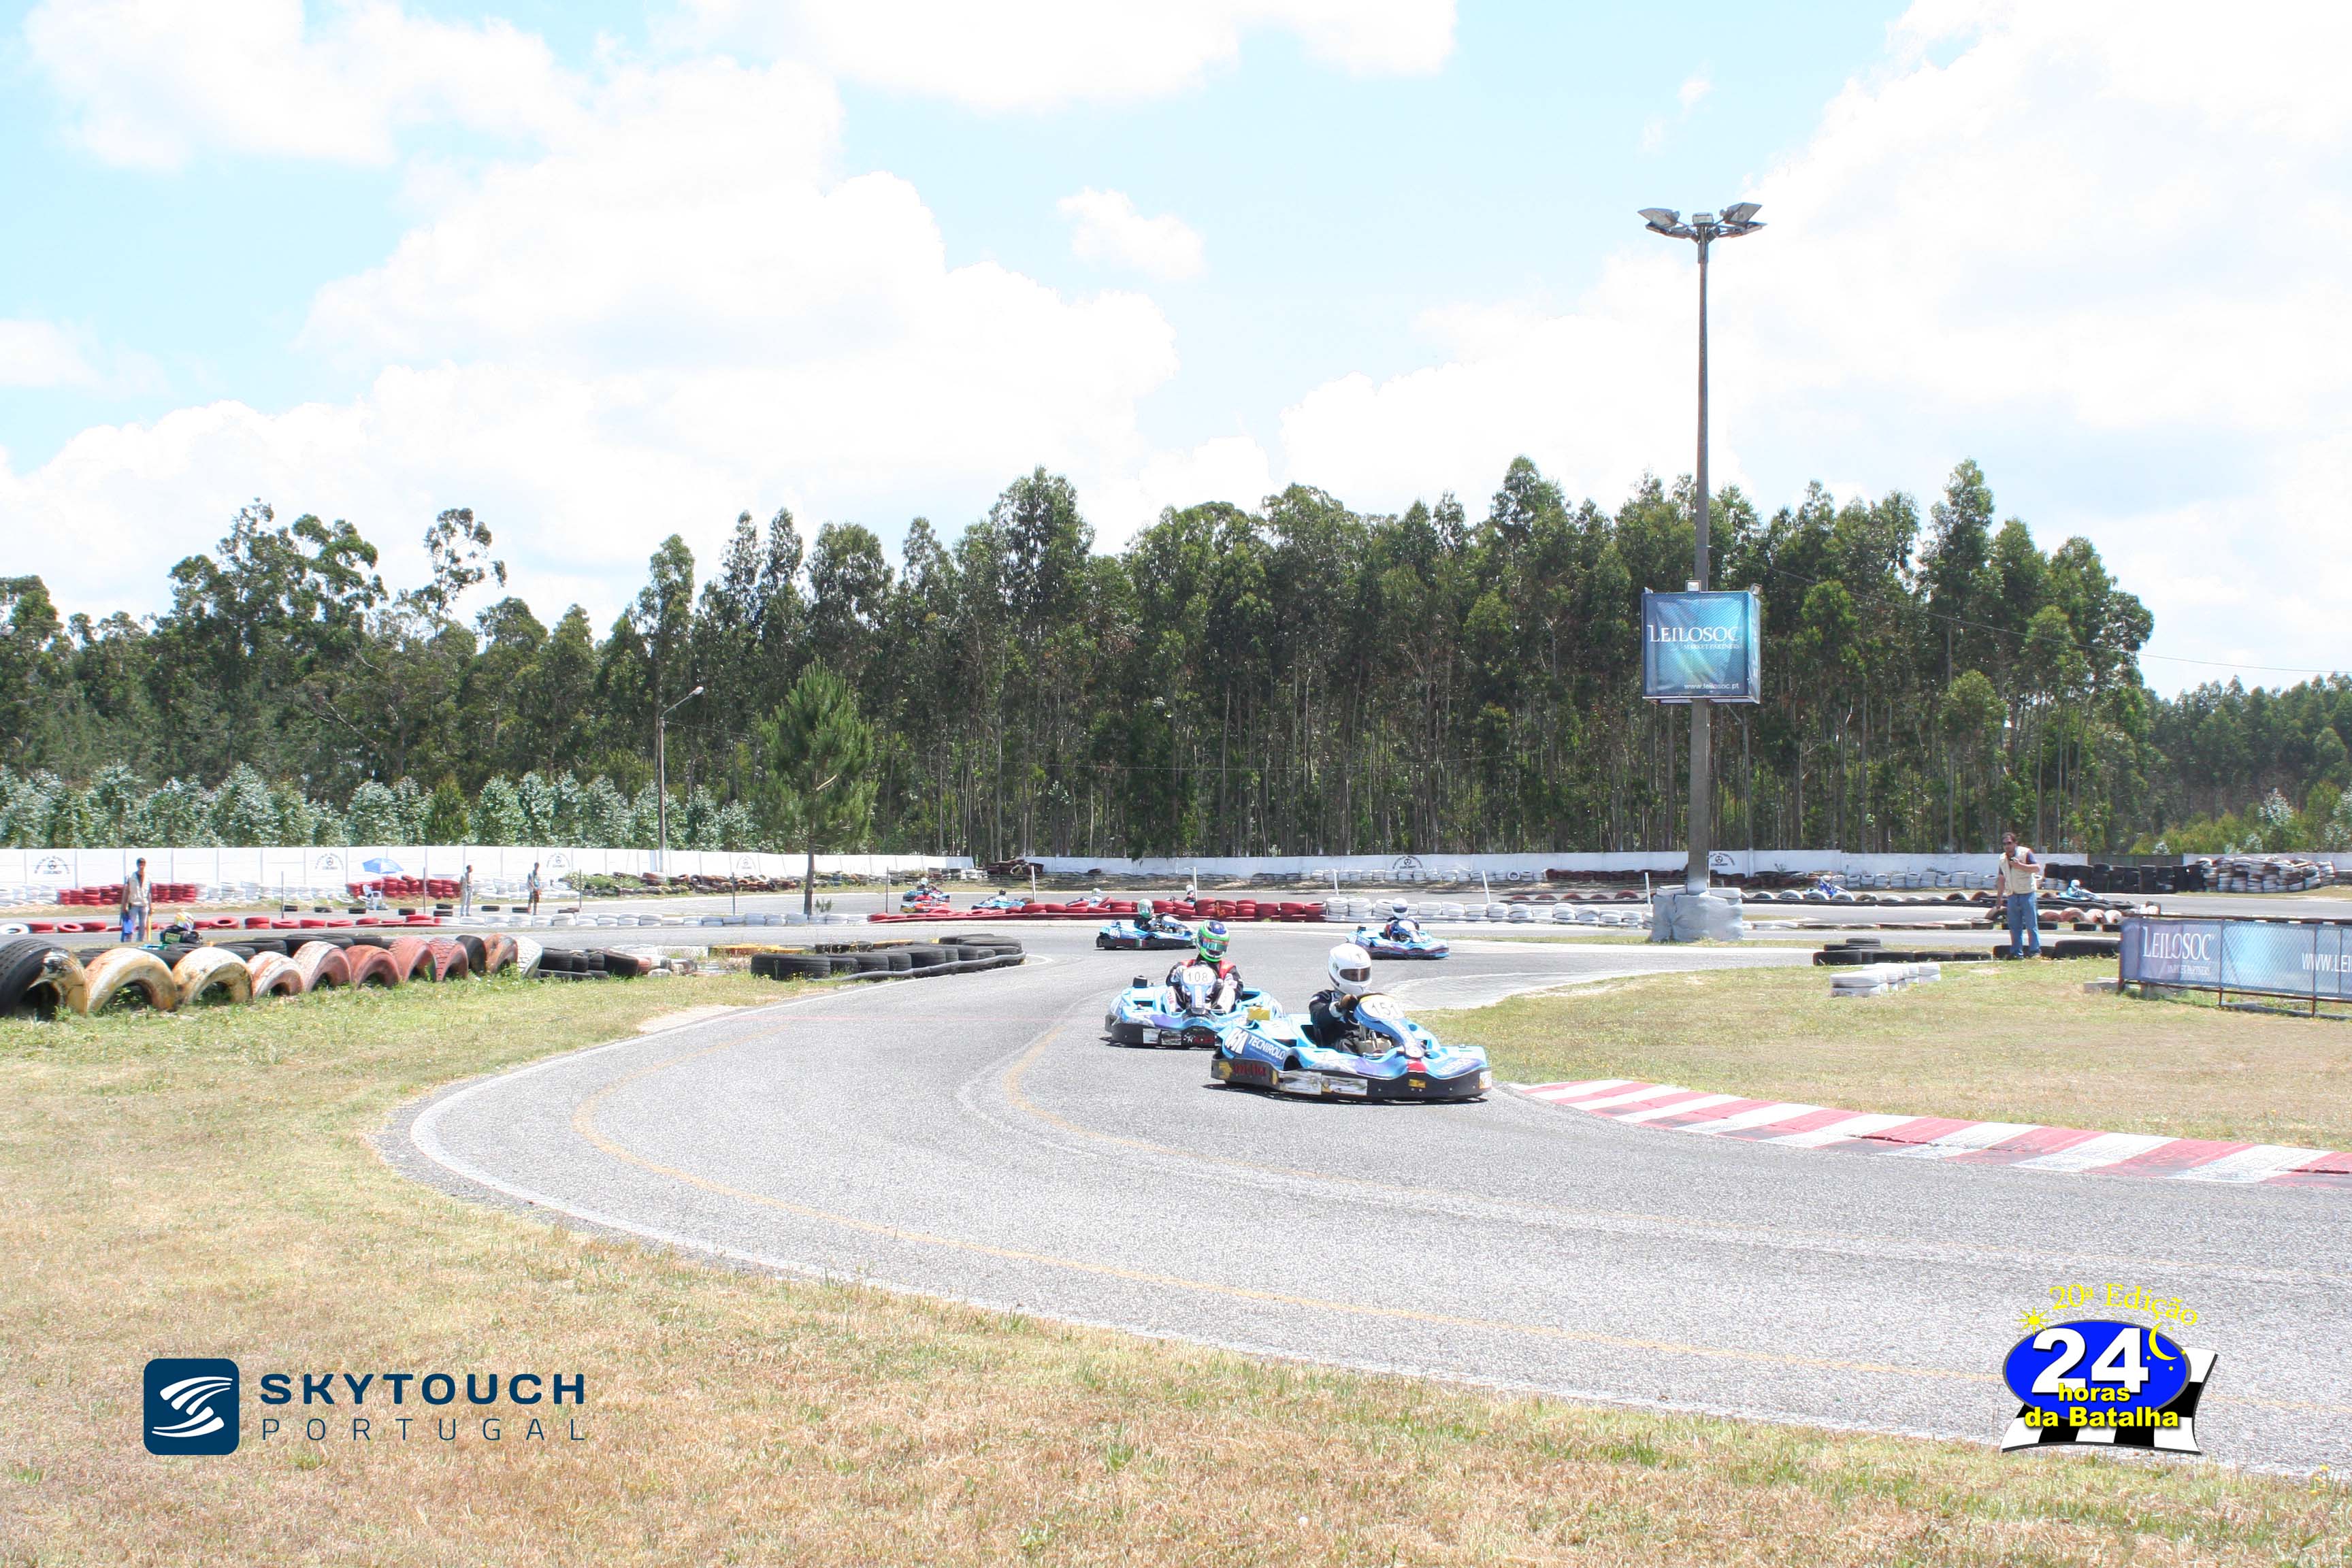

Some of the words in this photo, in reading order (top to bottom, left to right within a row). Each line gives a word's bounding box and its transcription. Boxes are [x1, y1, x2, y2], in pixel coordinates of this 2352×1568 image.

[1647, 624, 1739, 642] LEILOSOC
[2142, 926, 2211, 961] LEILOSOC
[2302, 952, 2352, 973] WWW.LEI
[1188, 970, 1209, 983] 108
[1371, 1001, 1399, 1016] 151
[1248, 1034, 1286, 1060] TECNIROLO
